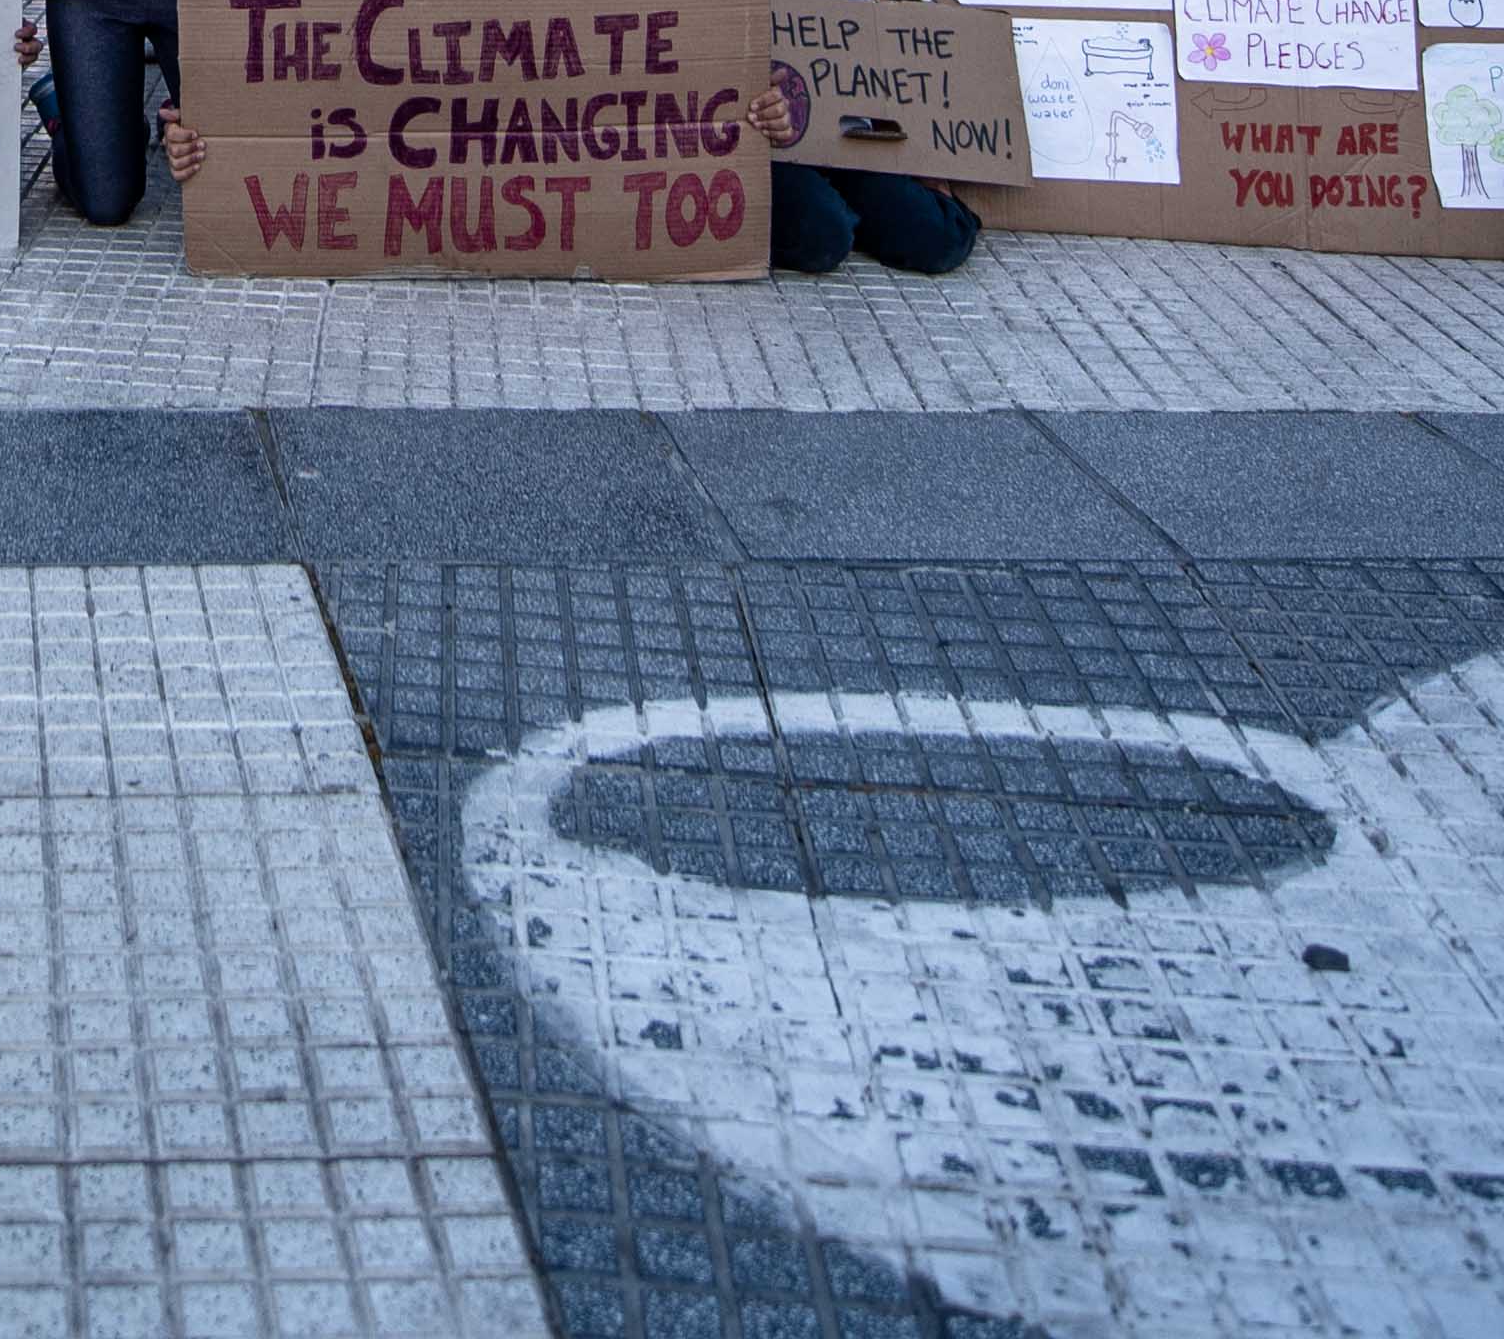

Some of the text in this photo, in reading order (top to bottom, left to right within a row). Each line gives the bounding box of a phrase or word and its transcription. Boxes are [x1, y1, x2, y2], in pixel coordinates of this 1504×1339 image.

[772, 10, 956, 60] HELP THE
[1246, 32, 1366, 71] PLEDGES
[810, 58, 952, 109] PLANET!
[1027, 91, 1078, 106] waste
[386, 88, 742, 169] CHANGING
[1030, 108, 1076, 121] water
[931, 118, 1014, 160] NOW!
[1221, 122, 1400, 155] WHAT ARE
[383, 169, 746, 258] MUST TOO
[1228, 168, 1429, 219] YOU DOING?
